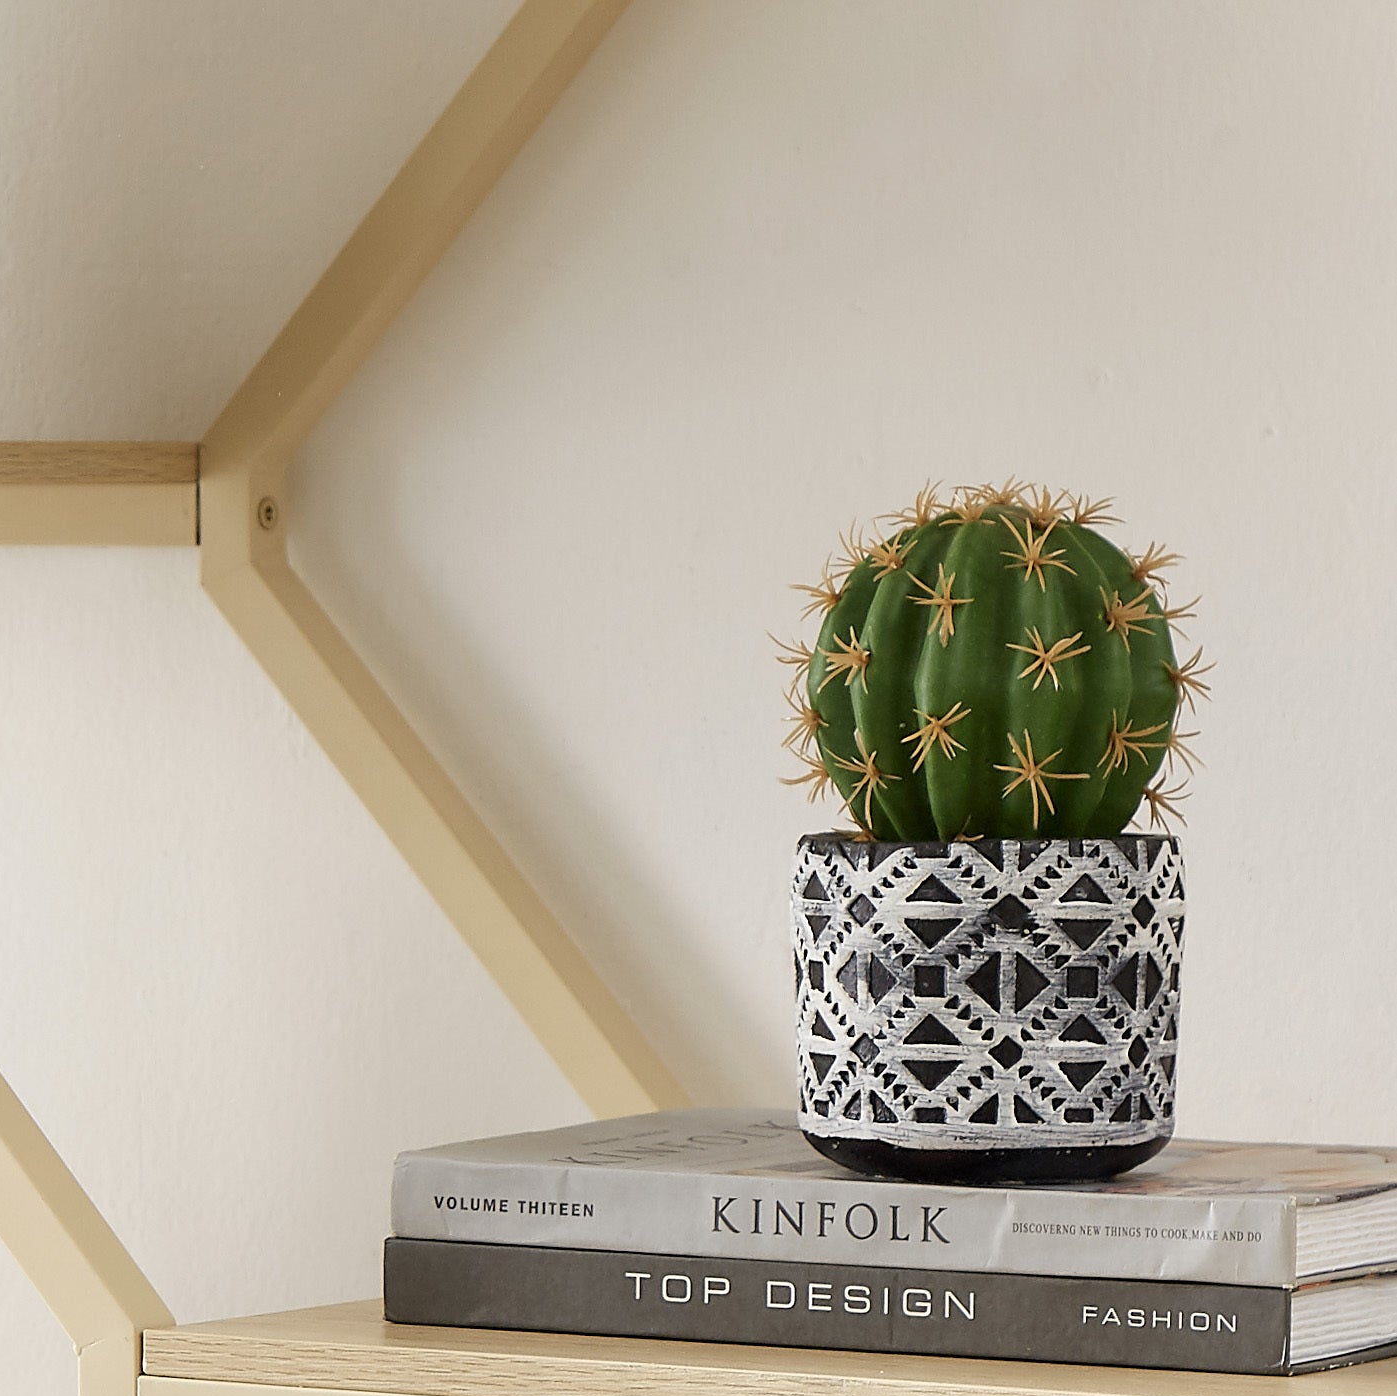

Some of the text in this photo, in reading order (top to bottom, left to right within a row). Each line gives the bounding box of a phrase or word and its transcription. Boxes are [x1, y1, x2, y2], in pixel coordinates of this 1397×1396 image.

[434, 1195, 595, 1217] VOLUME THITEEN
[711, 1196, 952, 1244] KINFOLK
[1012, 1222, 1076, 1235] DISCOVERNG
[1079, 1224, 1102, 1236] NEW
[1105, 1225, 1142, 1238] THINGS
[1145, 1227, 1158, 1239] TO
[1222, 1230, 1244, 1241] AND
[1247, 1231, 1262, 1242] DO
[625, 1272, 977, 1320] TOP DESIGN
[1082, 1305, 1238, 1333] FASHION
